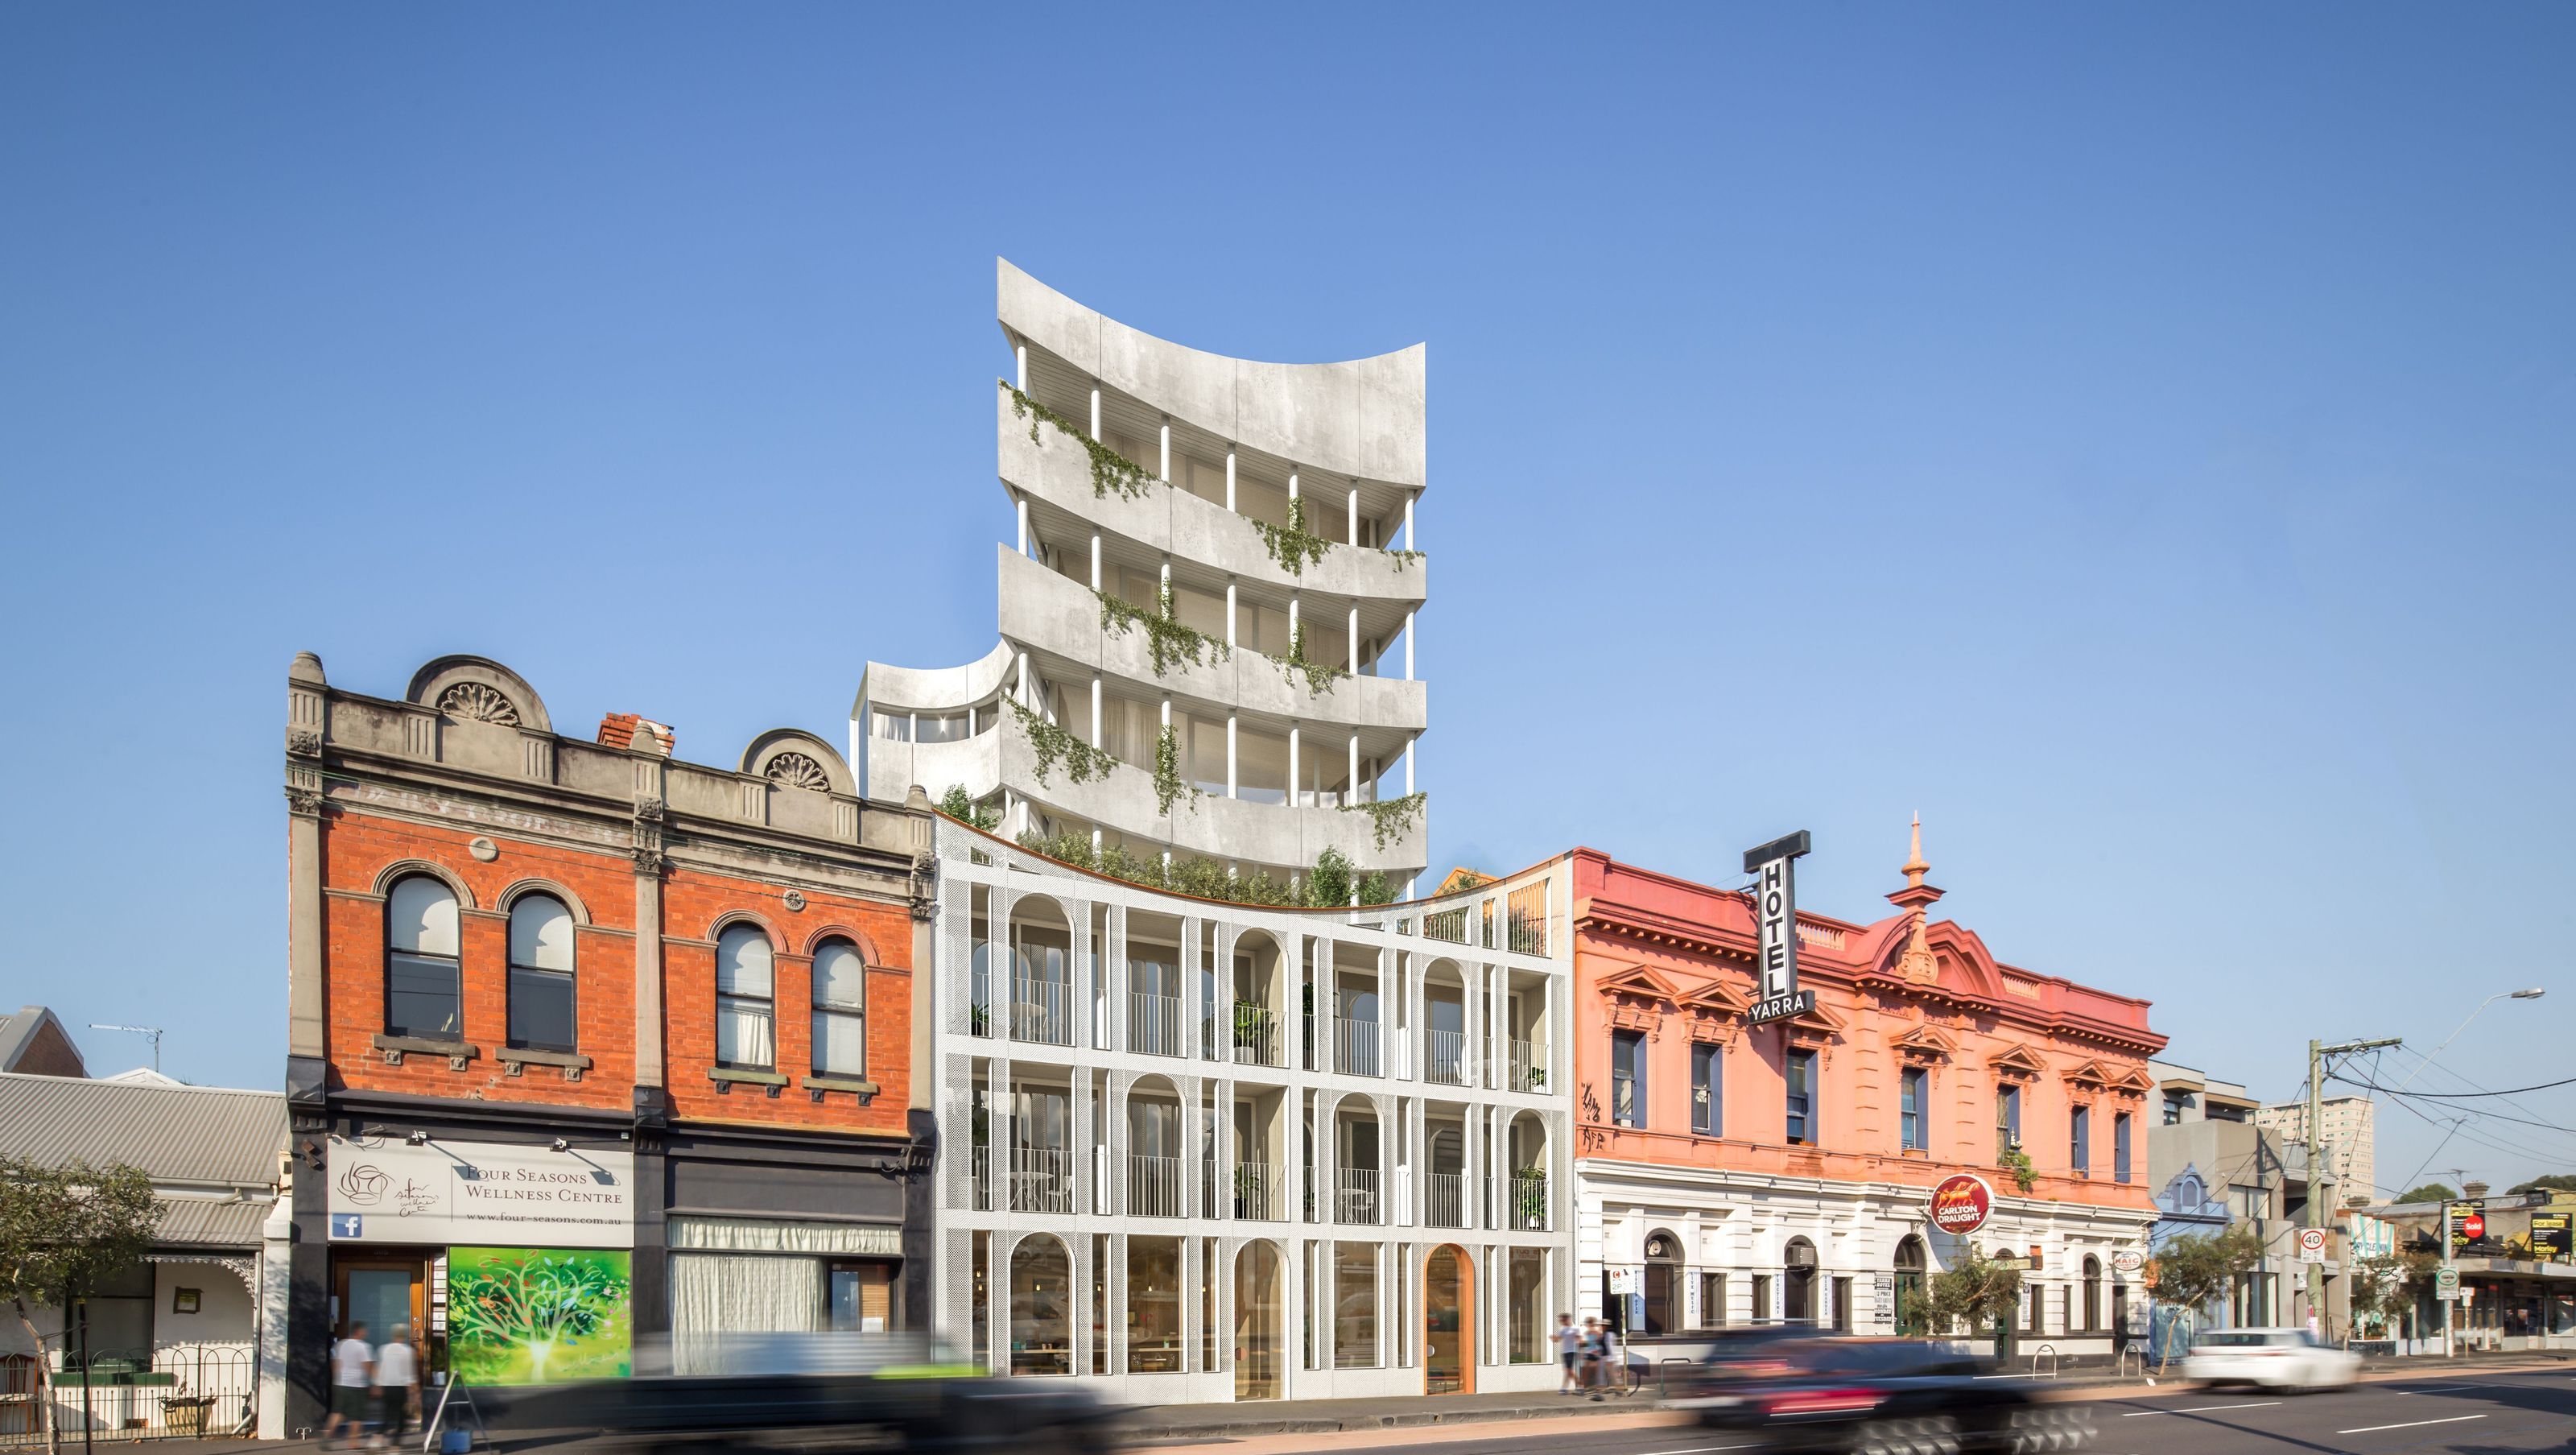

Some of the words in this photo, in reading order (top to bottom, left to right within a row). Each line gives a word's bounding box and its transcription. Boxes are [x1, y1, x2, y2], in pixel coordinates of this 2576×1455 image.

[1765, 862, 1785, 998] HOTEL
[1751, 994, 1804, 1020] YARRA
[468, 1166, 510, 1180] FOUR
[517, 1168, 587, 1184] SEASONS
[464, 1184, 552, 1201] WELLNESS
[559, 1188, 622, 1204] CENTRE
[1938, 1205, 1978, 1215] CARLTON
[467, 1212, 621, 1225] www.four-seasons.com.au
[1938, 1213, 1981, 1224] DRAUGHT
[2305, 1236, 2320, 1244] 40
